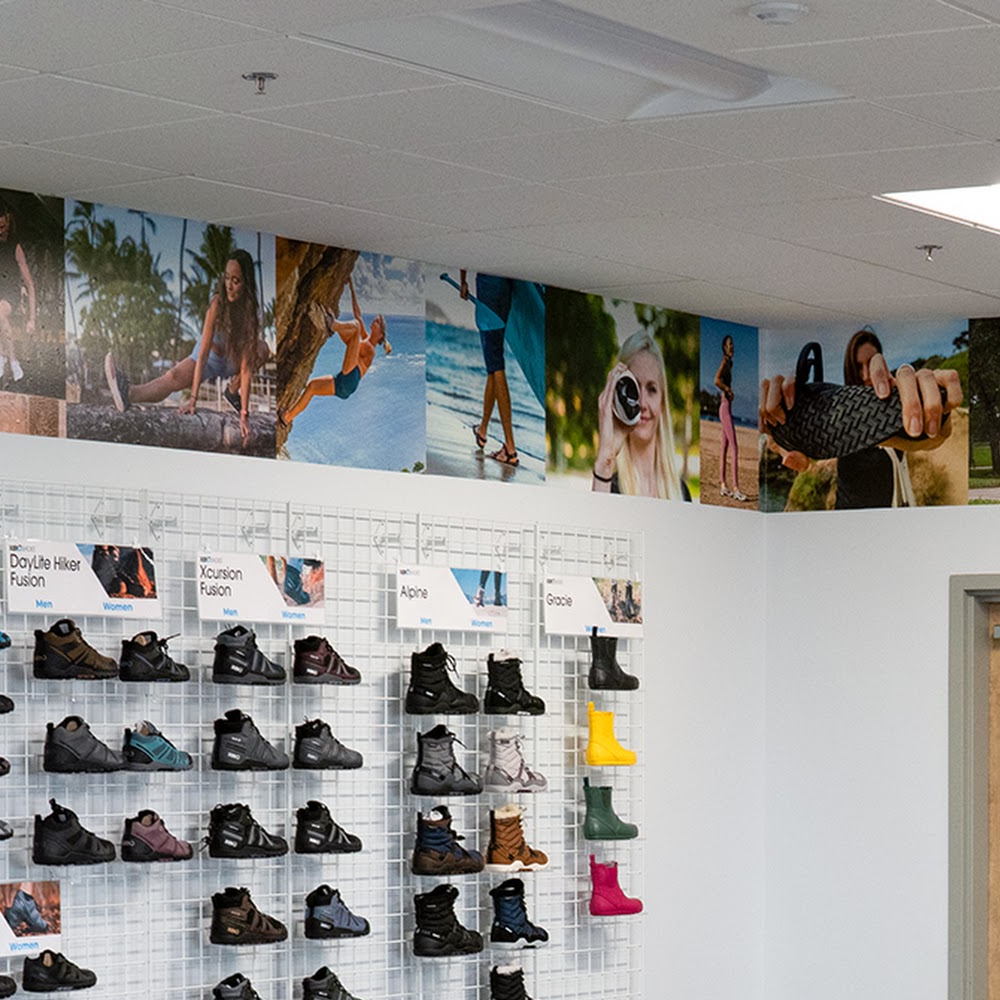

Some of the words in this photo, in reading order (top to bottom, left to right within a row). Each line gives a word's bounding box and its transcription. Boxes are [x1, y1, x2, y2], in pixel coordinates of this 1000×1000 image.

[9, 553, 52, 572] DayLite
[53, 556, 81, 571] Hiker
[10, 571, 46, 587] Fusion
[200, 565, 243, 580] Xcursion
[200, 582, 232, 596] Fusion
[400, 585, 429, 600] Alpine
[35, 600, 53, 609] Men
[103, 602, 133, 611] Women
[546, 593, 573, 607] Gracie
[222, 608, 238, 616] Men
[9, 941, 40, 951] Women
